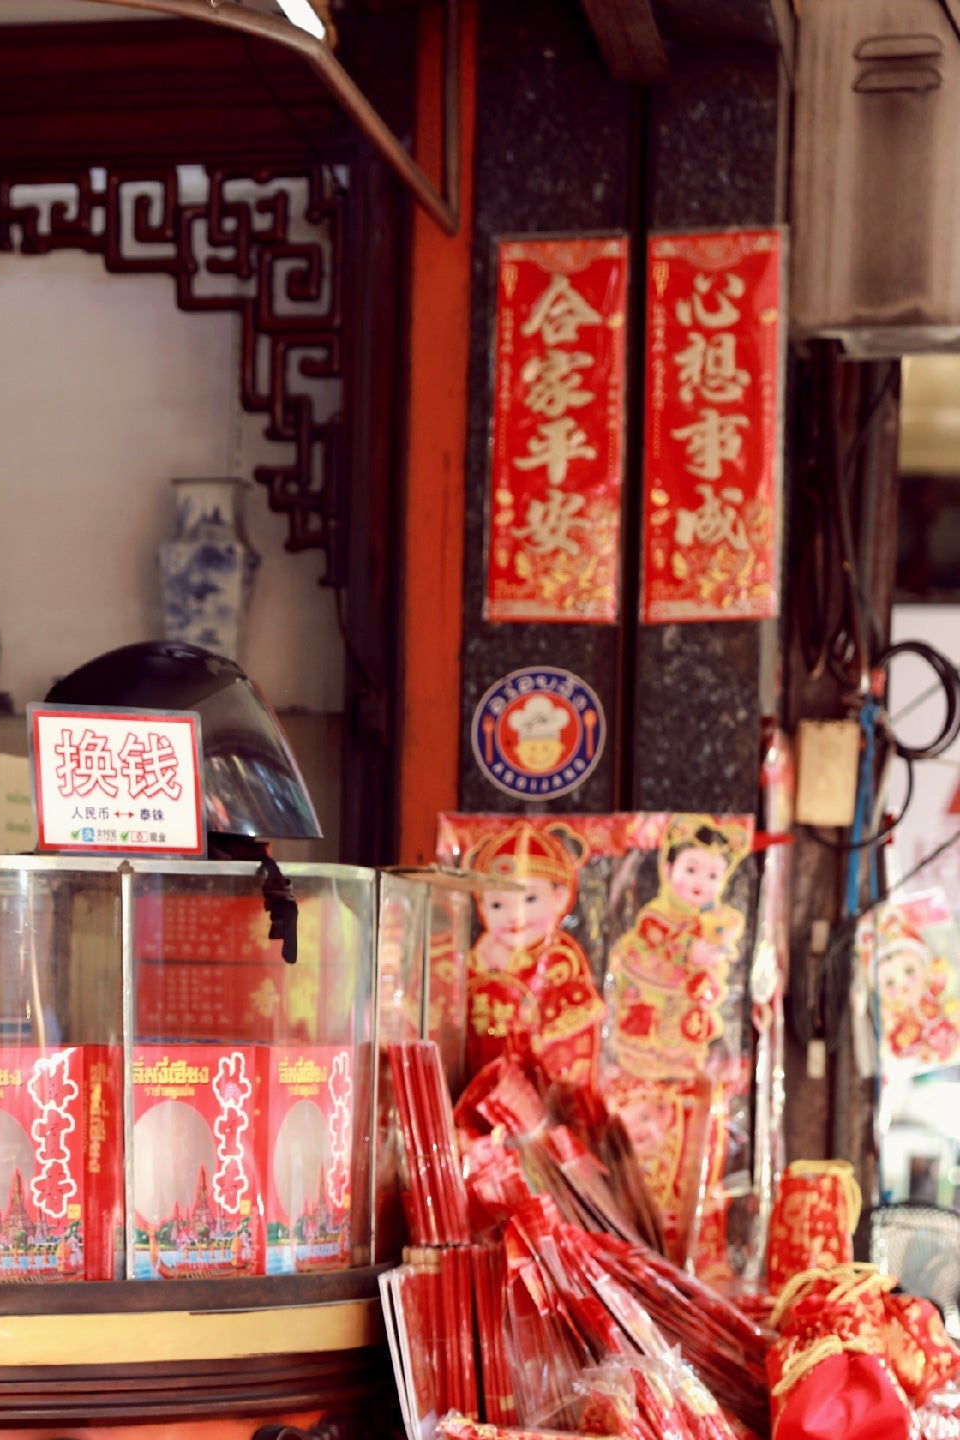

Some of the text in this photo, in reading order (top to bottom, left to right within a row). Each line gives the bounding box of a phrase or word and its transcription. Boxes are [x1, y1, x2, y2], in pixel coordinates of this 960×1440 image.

[512, 272, 603, 556] 合家平安
[671, 271, 752, 552] 心想事成
[54, 728, 183, 801] 换钱
[71, 806, 110, 820] 人民币
